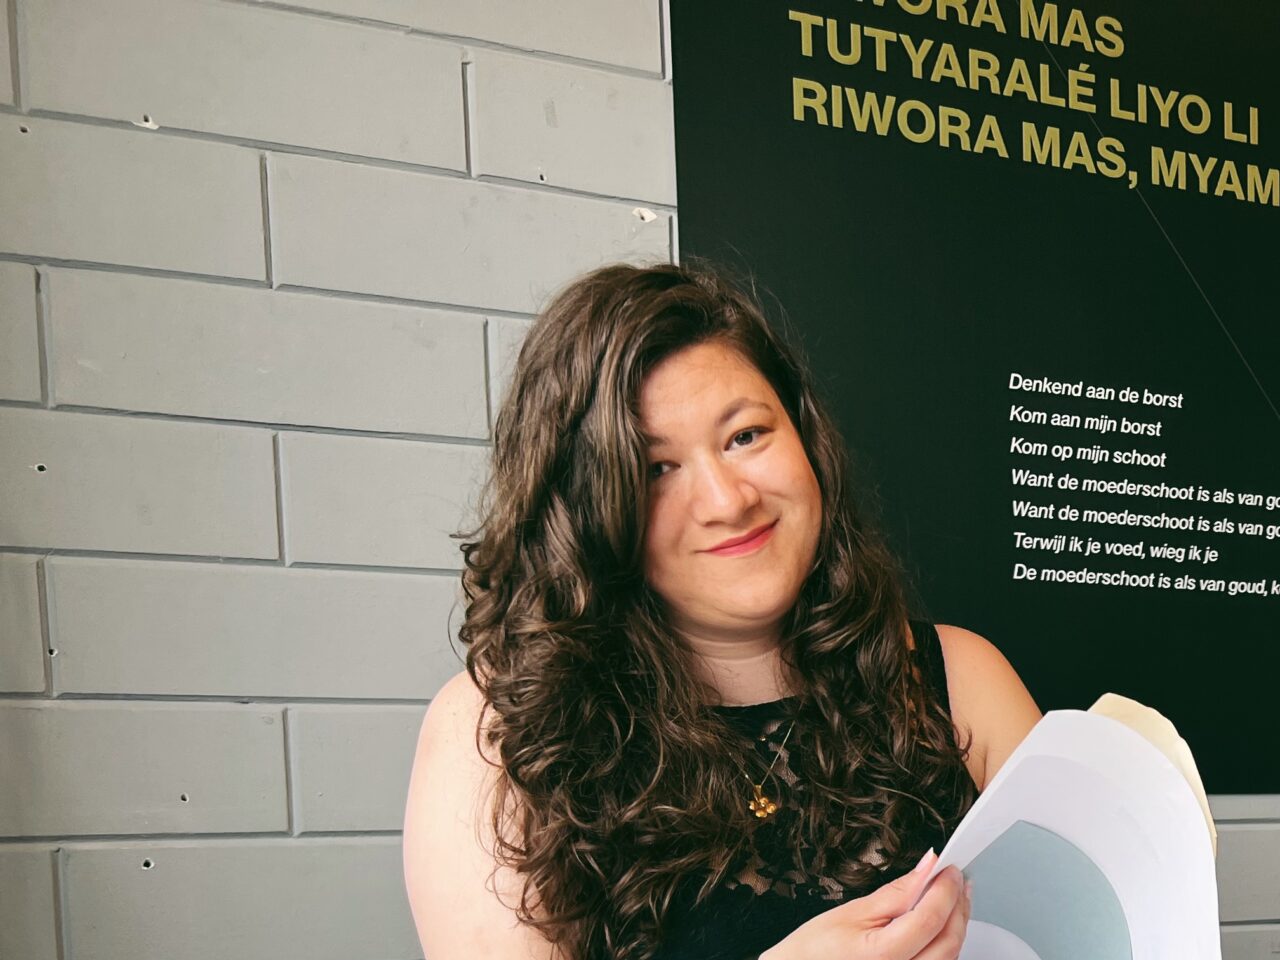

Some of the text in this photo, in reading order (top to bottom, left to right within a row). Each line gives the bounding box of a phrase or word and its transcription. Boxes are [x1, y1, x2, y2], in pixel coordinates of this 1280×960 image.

[1020, 0, 1125, 58] MAS
[788, 9, 1259, 145] TUTYARALÉ LIYO LI
[792, 77, 1009, 159] RIWORA
[1022, 121, 1138, 190] MAS,
[1008, 372, 1184, 408] Denkend aan de borst
[1009, 405, 1162, 436] Kom aan mijn borst
[1010, 437, 1167, 468] Kom op mijn schoot
[1011, 468, 1054, 488] Want
[1058, 474, 1079, 490] de
[1082, 479, 1195, 501] moederschoot
[1197, 486, 1211, 502] is
[1213, 488, 1235, 504] als
[1238, 493, 1263, 507] van
[1012, 500, 1055, 520] Want
[1058, 505, 1080, 521] de
[1083, 509, 1195, 530] moederschoot
[1197, 516, 1211, 531] is
[1213, 518, 1235, 534] als
[1238, 523, 1263, 536] van
[1013, 532, 1219, 564] Terwijl ik je voed, wieg ik je
[1012, 563, 1038, 580] De
[1041, 568, 1156, 588] moederschoot
[1158, 573, 1172, 589] is
[1174, 575, 1197, 591] als
[1199, 580, 1225, 592] van
[1228, 580, 1268, 597] goud,
